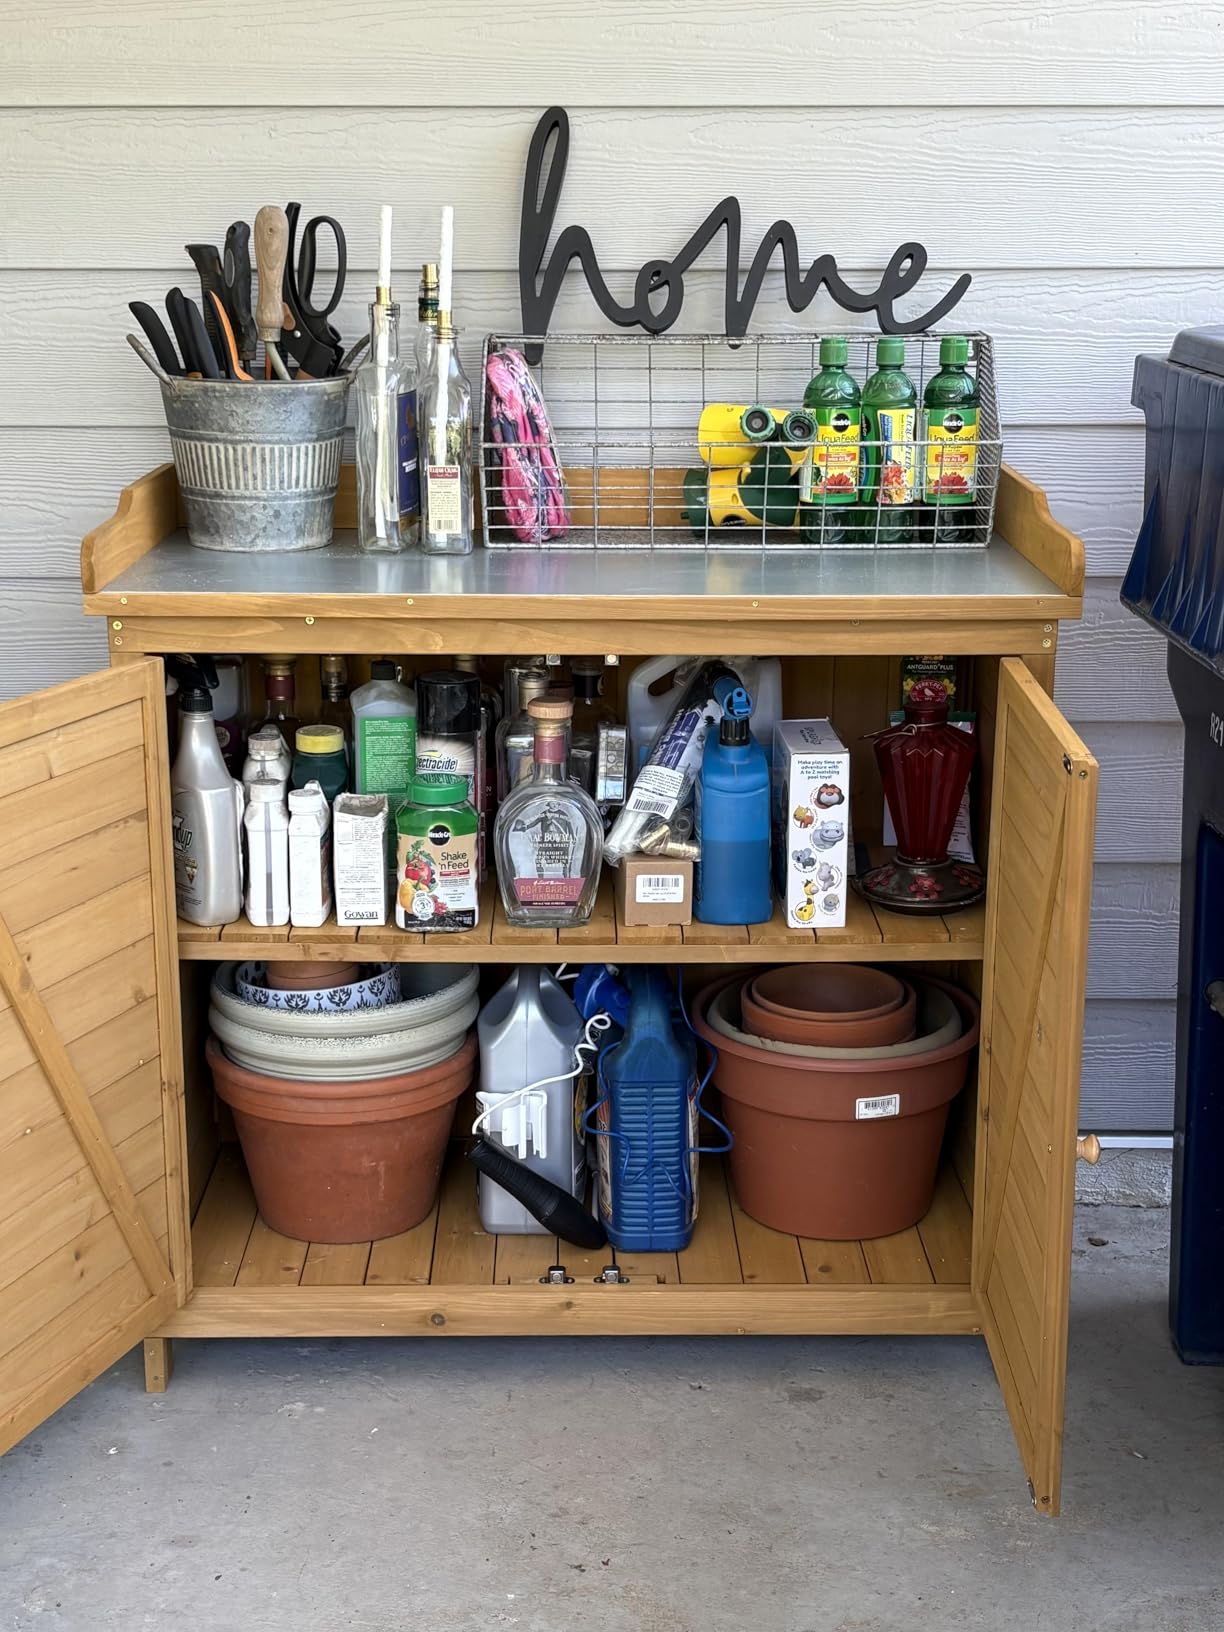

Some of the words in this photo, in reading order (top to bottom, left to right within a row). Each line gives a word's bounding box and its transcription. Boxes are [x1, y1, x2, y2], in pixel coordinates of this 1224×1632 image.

[518, 106, 971, 364] home
[416, 757, 456, 770] ectracide
[440, 851, 467, 861] Shake
[447, 859, 469, 870] Feed
[344, 909, 379, 919] Gowan
